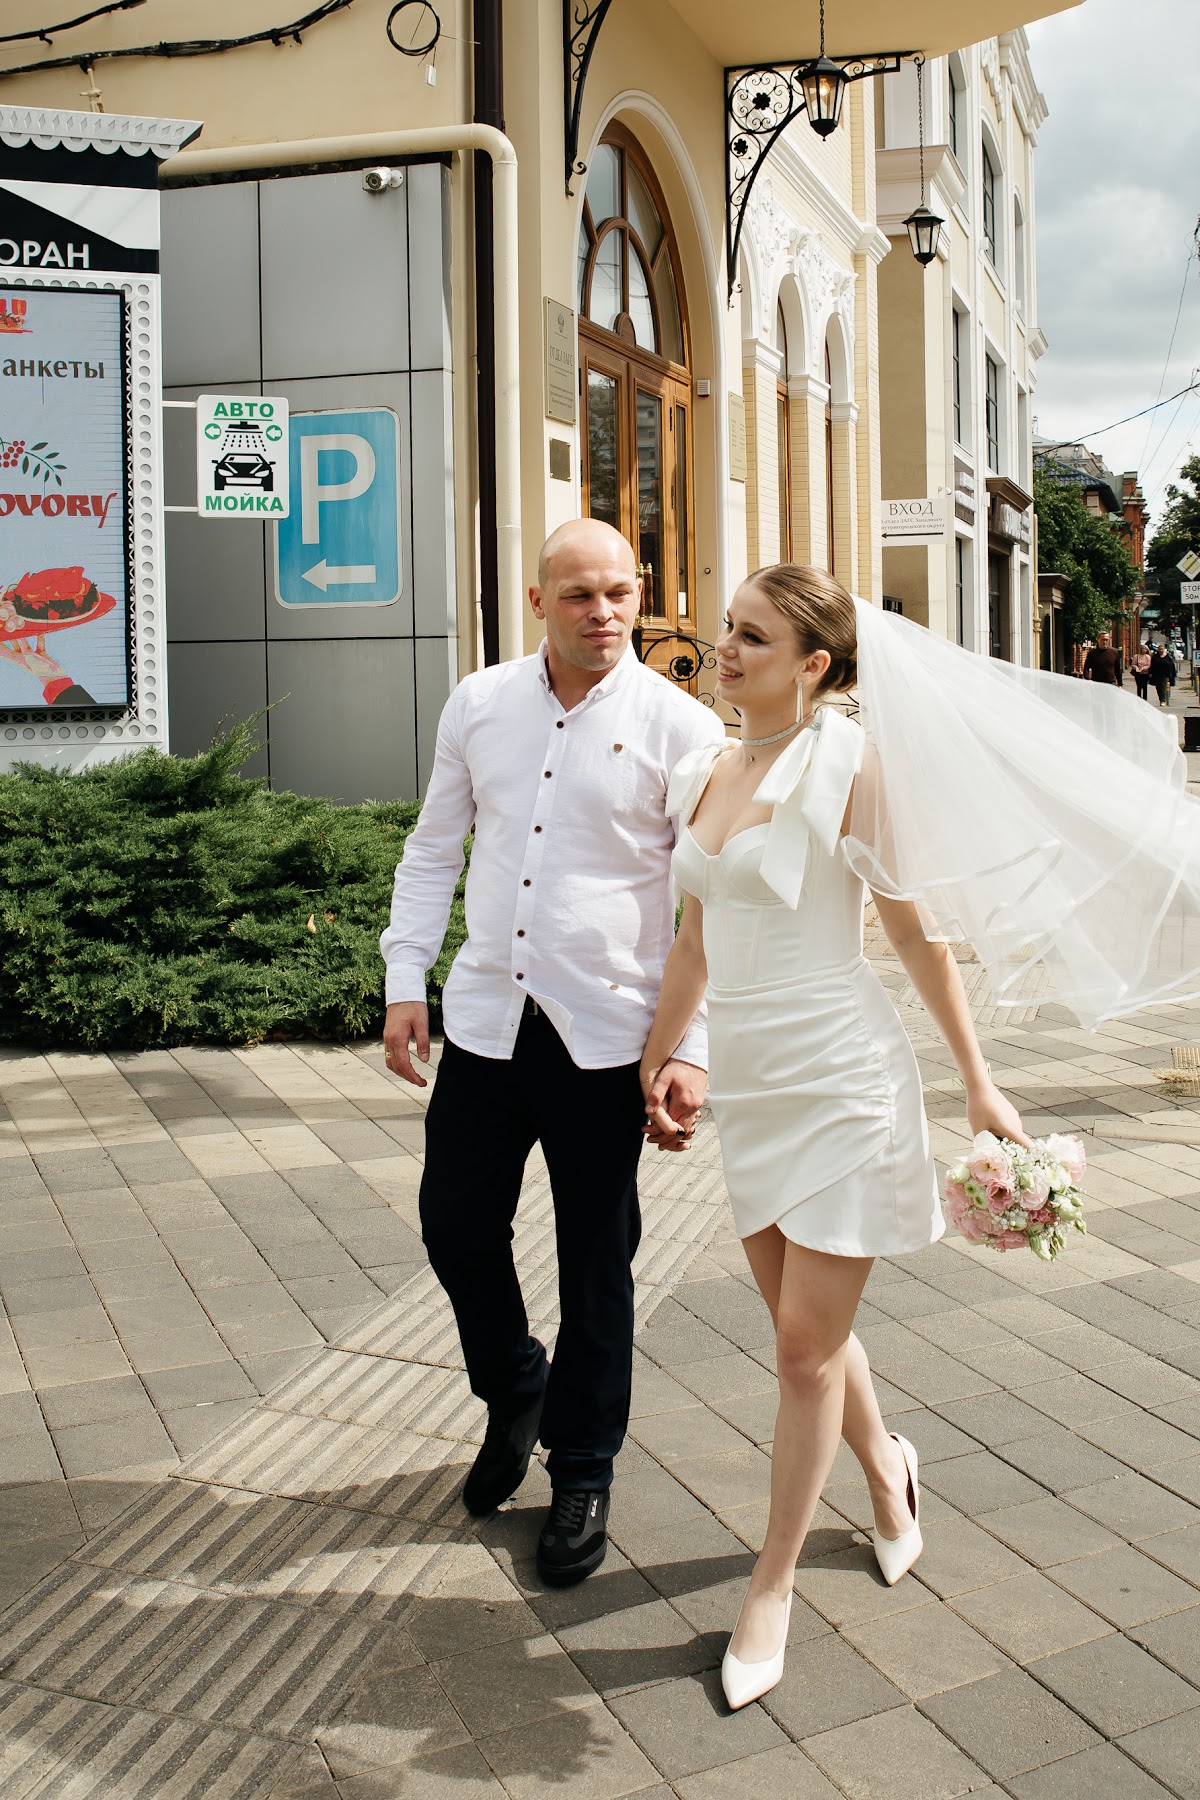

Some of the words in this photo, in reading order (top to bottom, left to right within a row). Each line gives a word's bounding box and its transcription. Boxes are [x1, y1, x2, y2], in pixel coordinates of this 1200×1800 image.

[0, 239, 90, 269] ОРАН
[2, 358, 105, 379] анкеты
[213, 402, 274, 418] АВТО
[300, 433, 376, 545] P
[205, 492, 284, 512] МОЙКА
[889, 501, 934, 517] ВХОД
